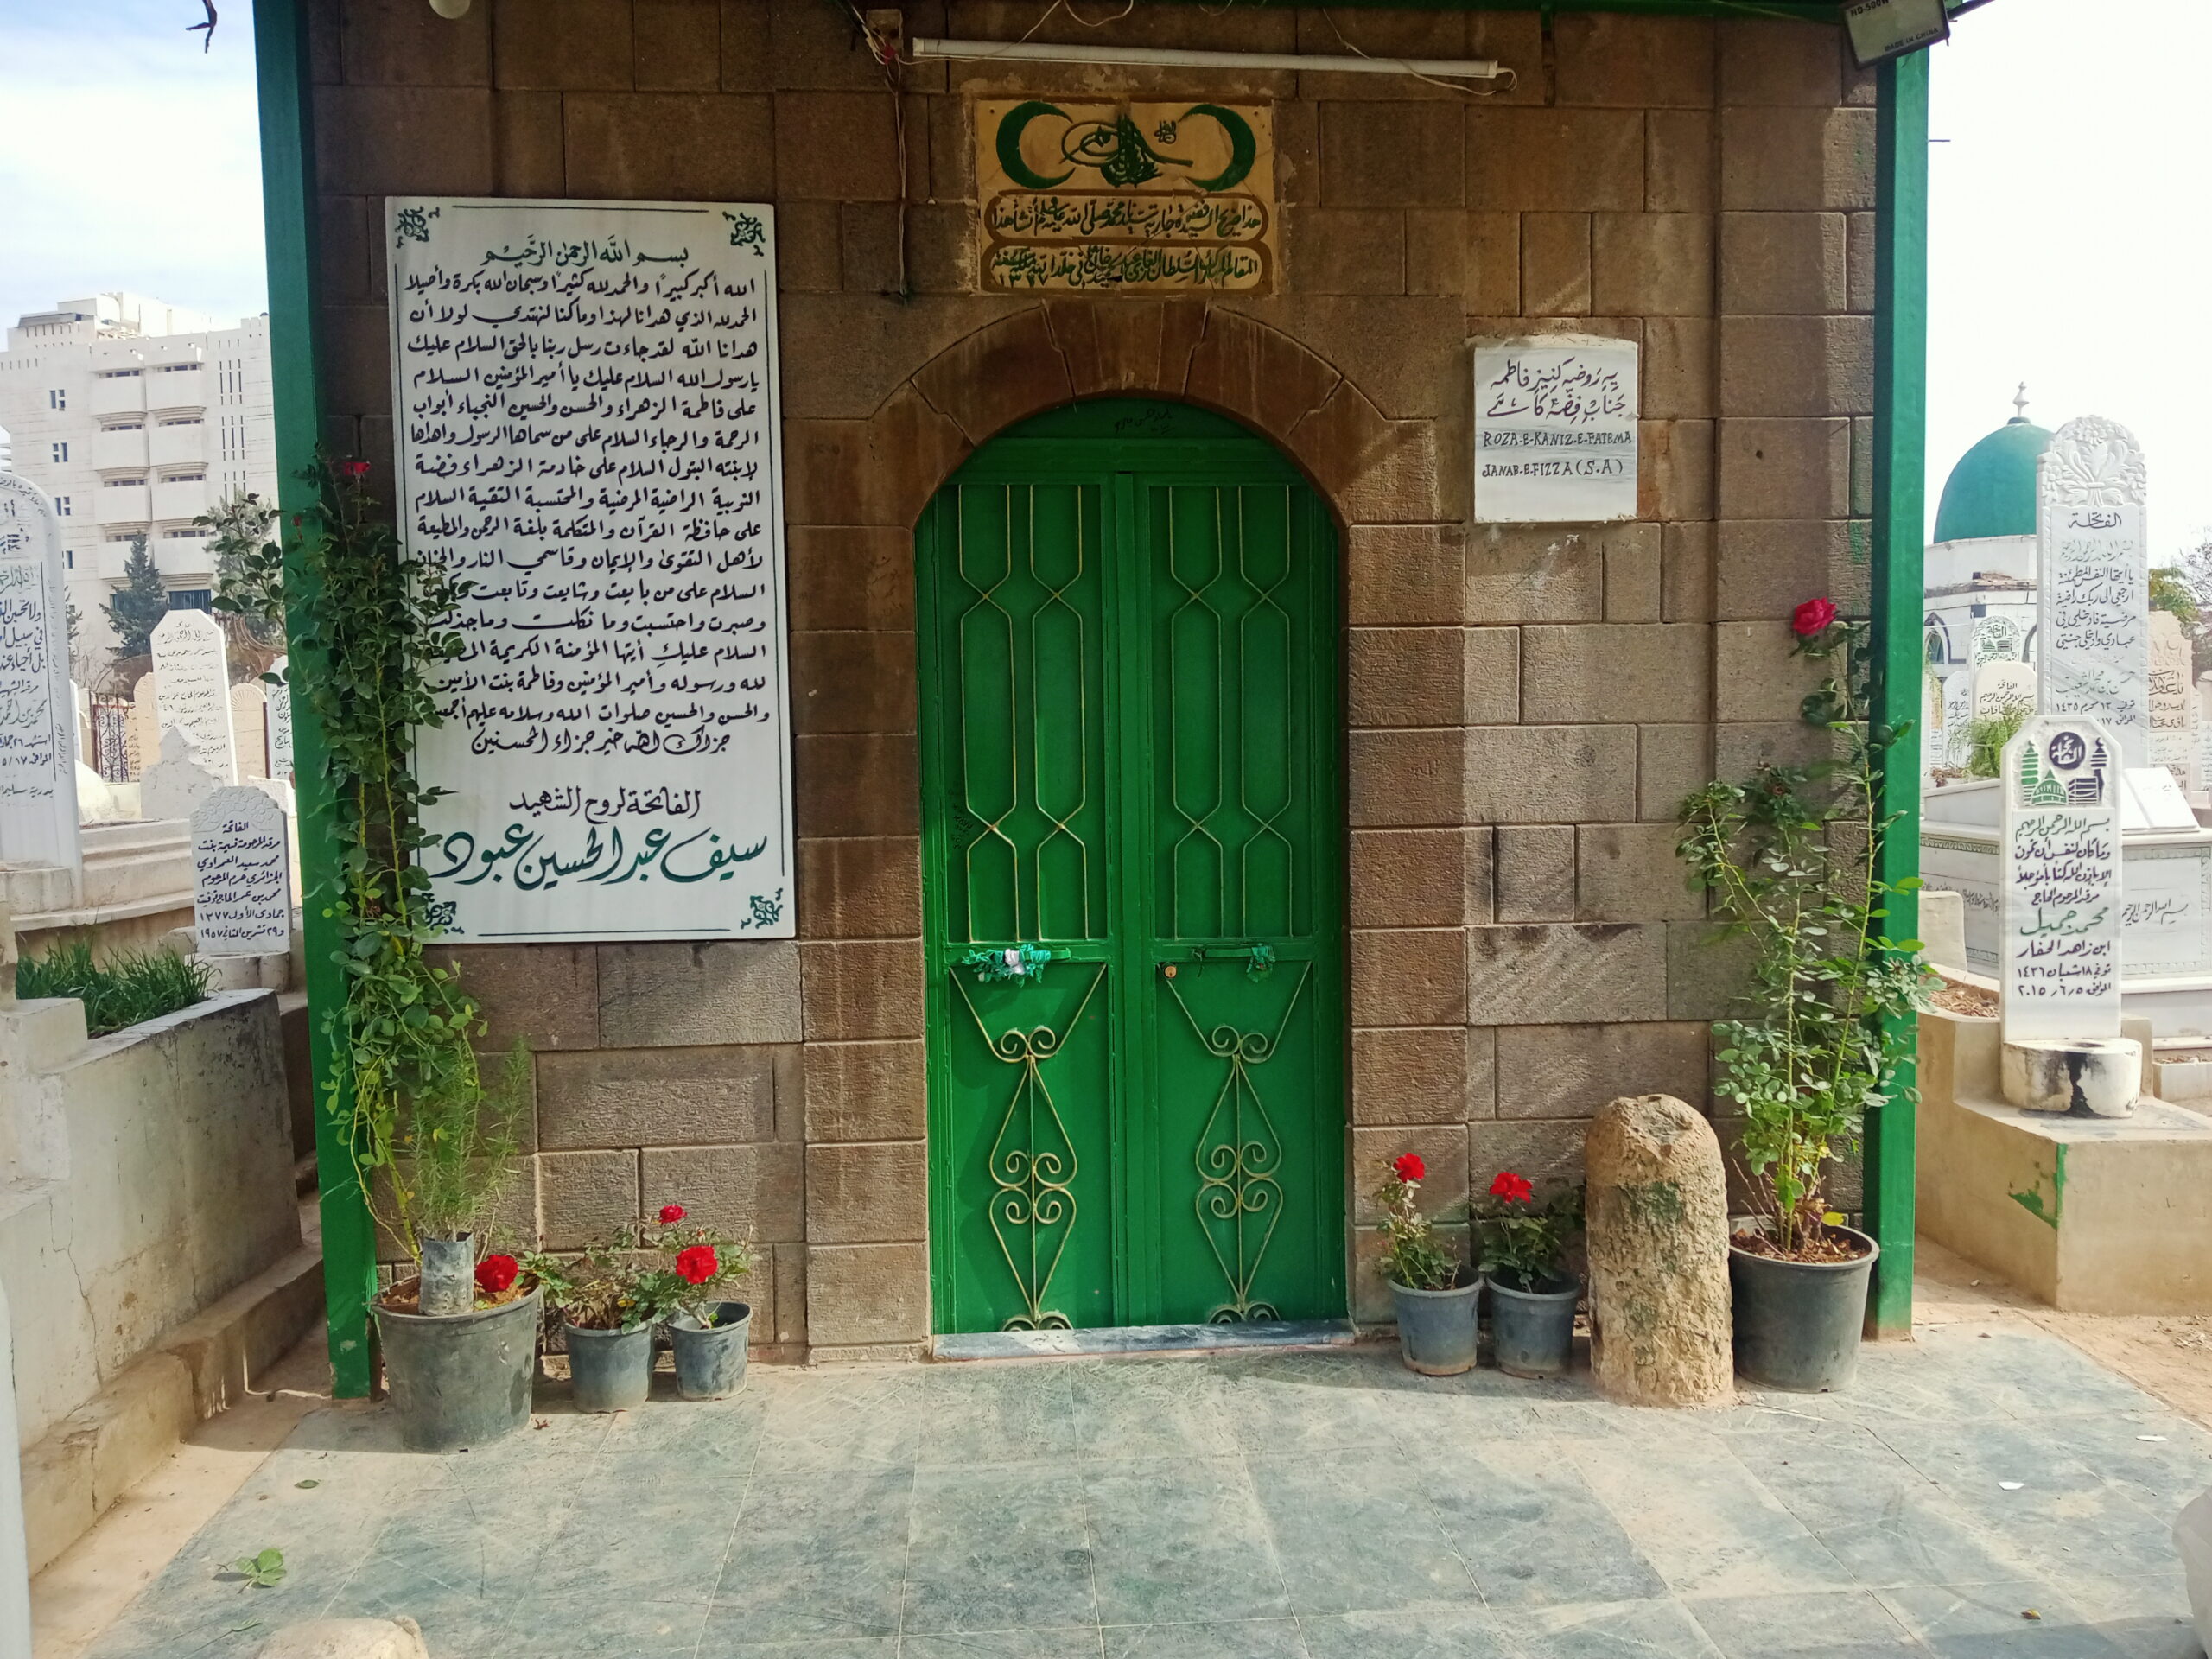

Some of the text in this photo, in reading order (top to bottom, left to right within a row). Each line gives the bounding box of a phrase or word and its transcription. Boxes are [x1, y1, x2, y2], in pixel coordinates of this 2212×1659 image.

[1885, 40, 1904, 51] MADE
[1916, 27, 1939, 40] CHINA
[509, 785, 701, 824] الفاتحة لروح الشهيد
[427, 823, 534, 885] عبود
[660, 827, 767, 883] سيف
